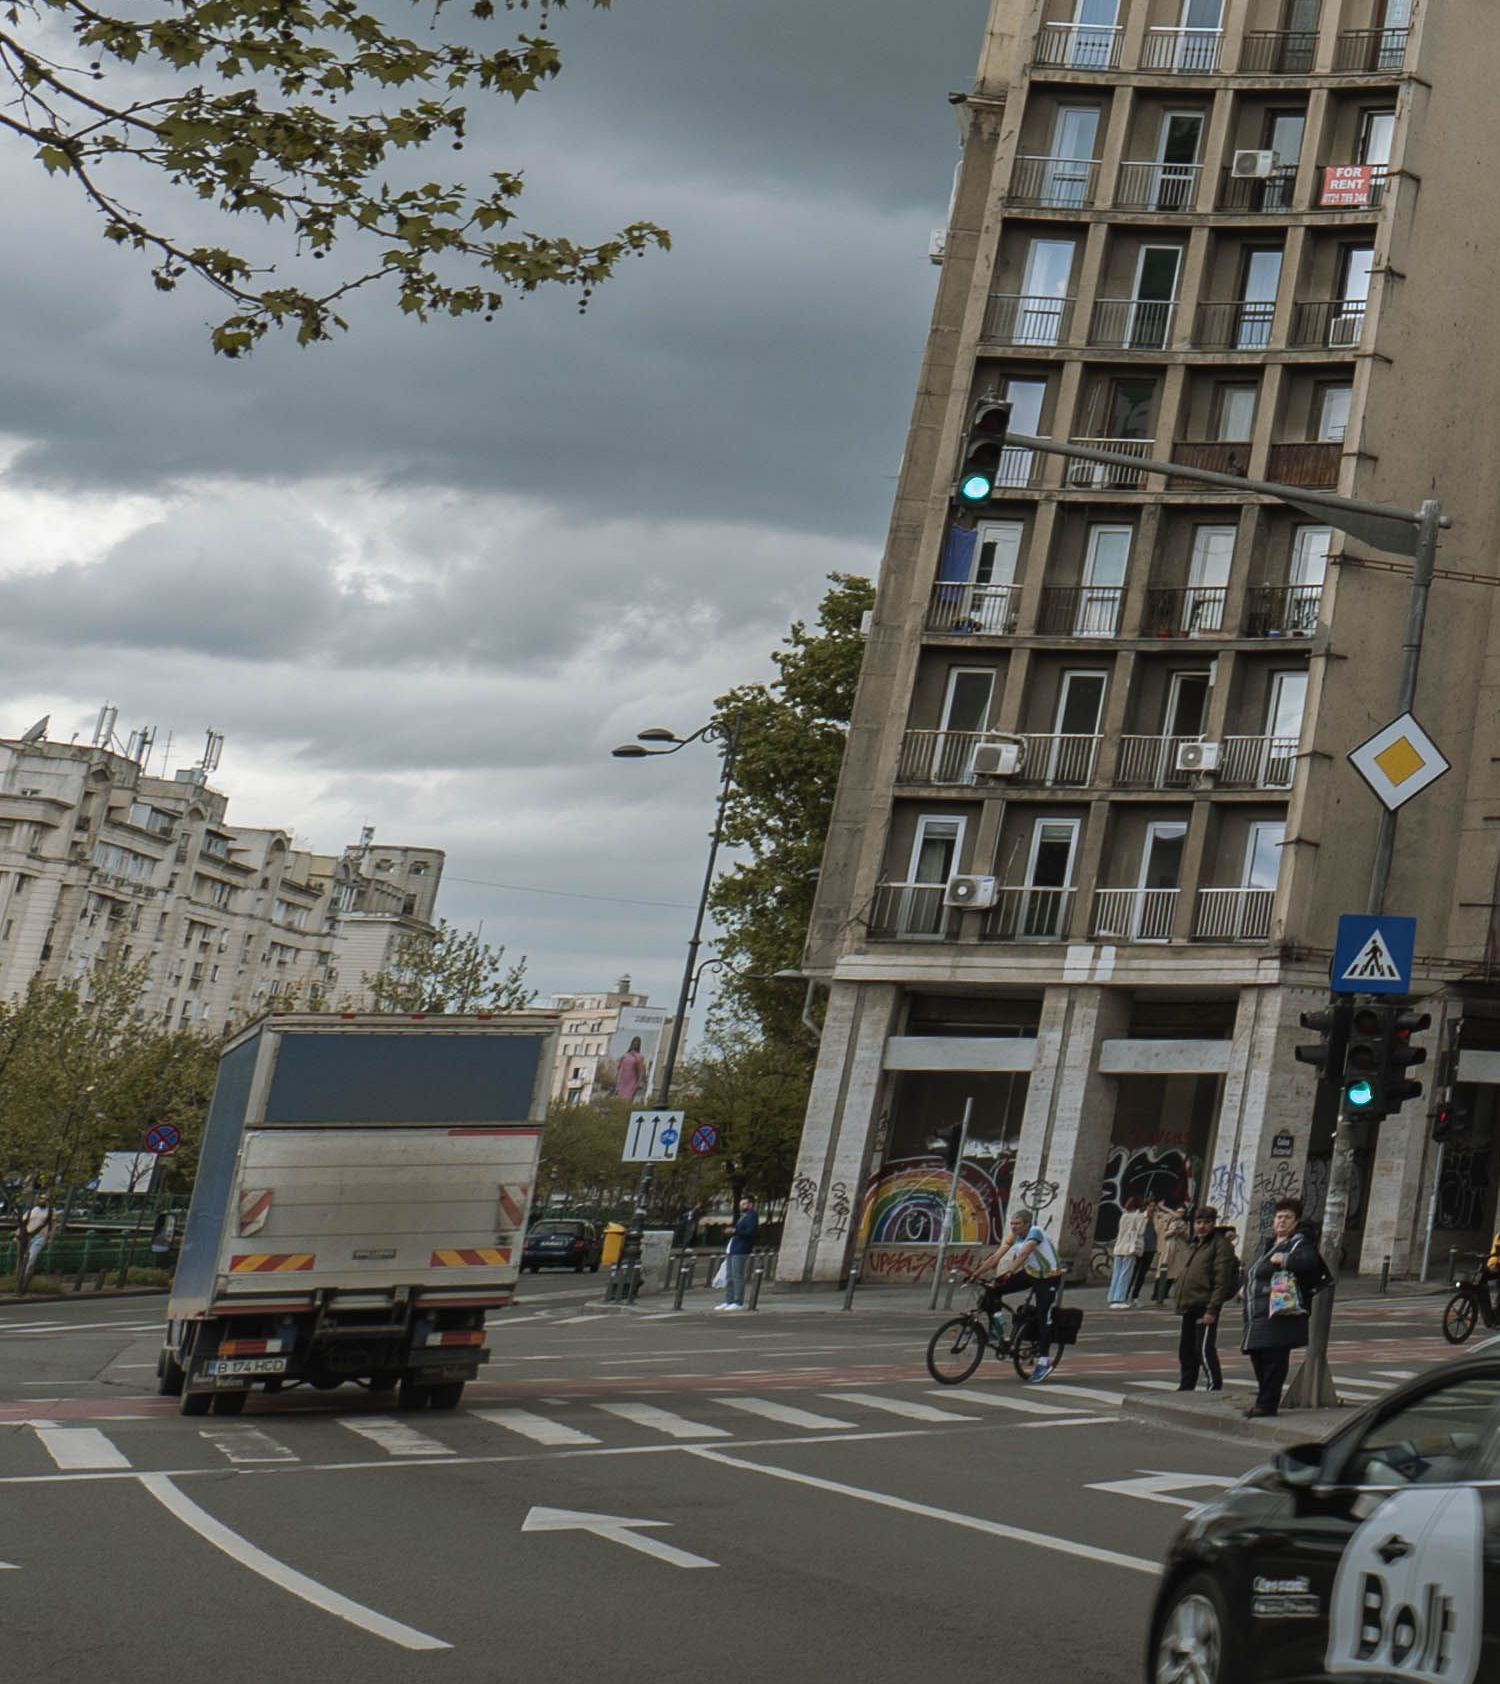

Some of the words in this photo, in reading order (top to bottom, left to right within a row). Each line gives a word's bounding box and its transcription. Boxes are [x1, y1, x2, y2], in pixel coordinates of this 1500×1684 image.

[1336, 167, 1362, 178] FOR
[1329, 179, 1364, 189] RENT
[217, 1360, 228, 1374] B
[232, 1359, 251, 1373] 174
[1352, 1571, 1457, 1676] Bolt
